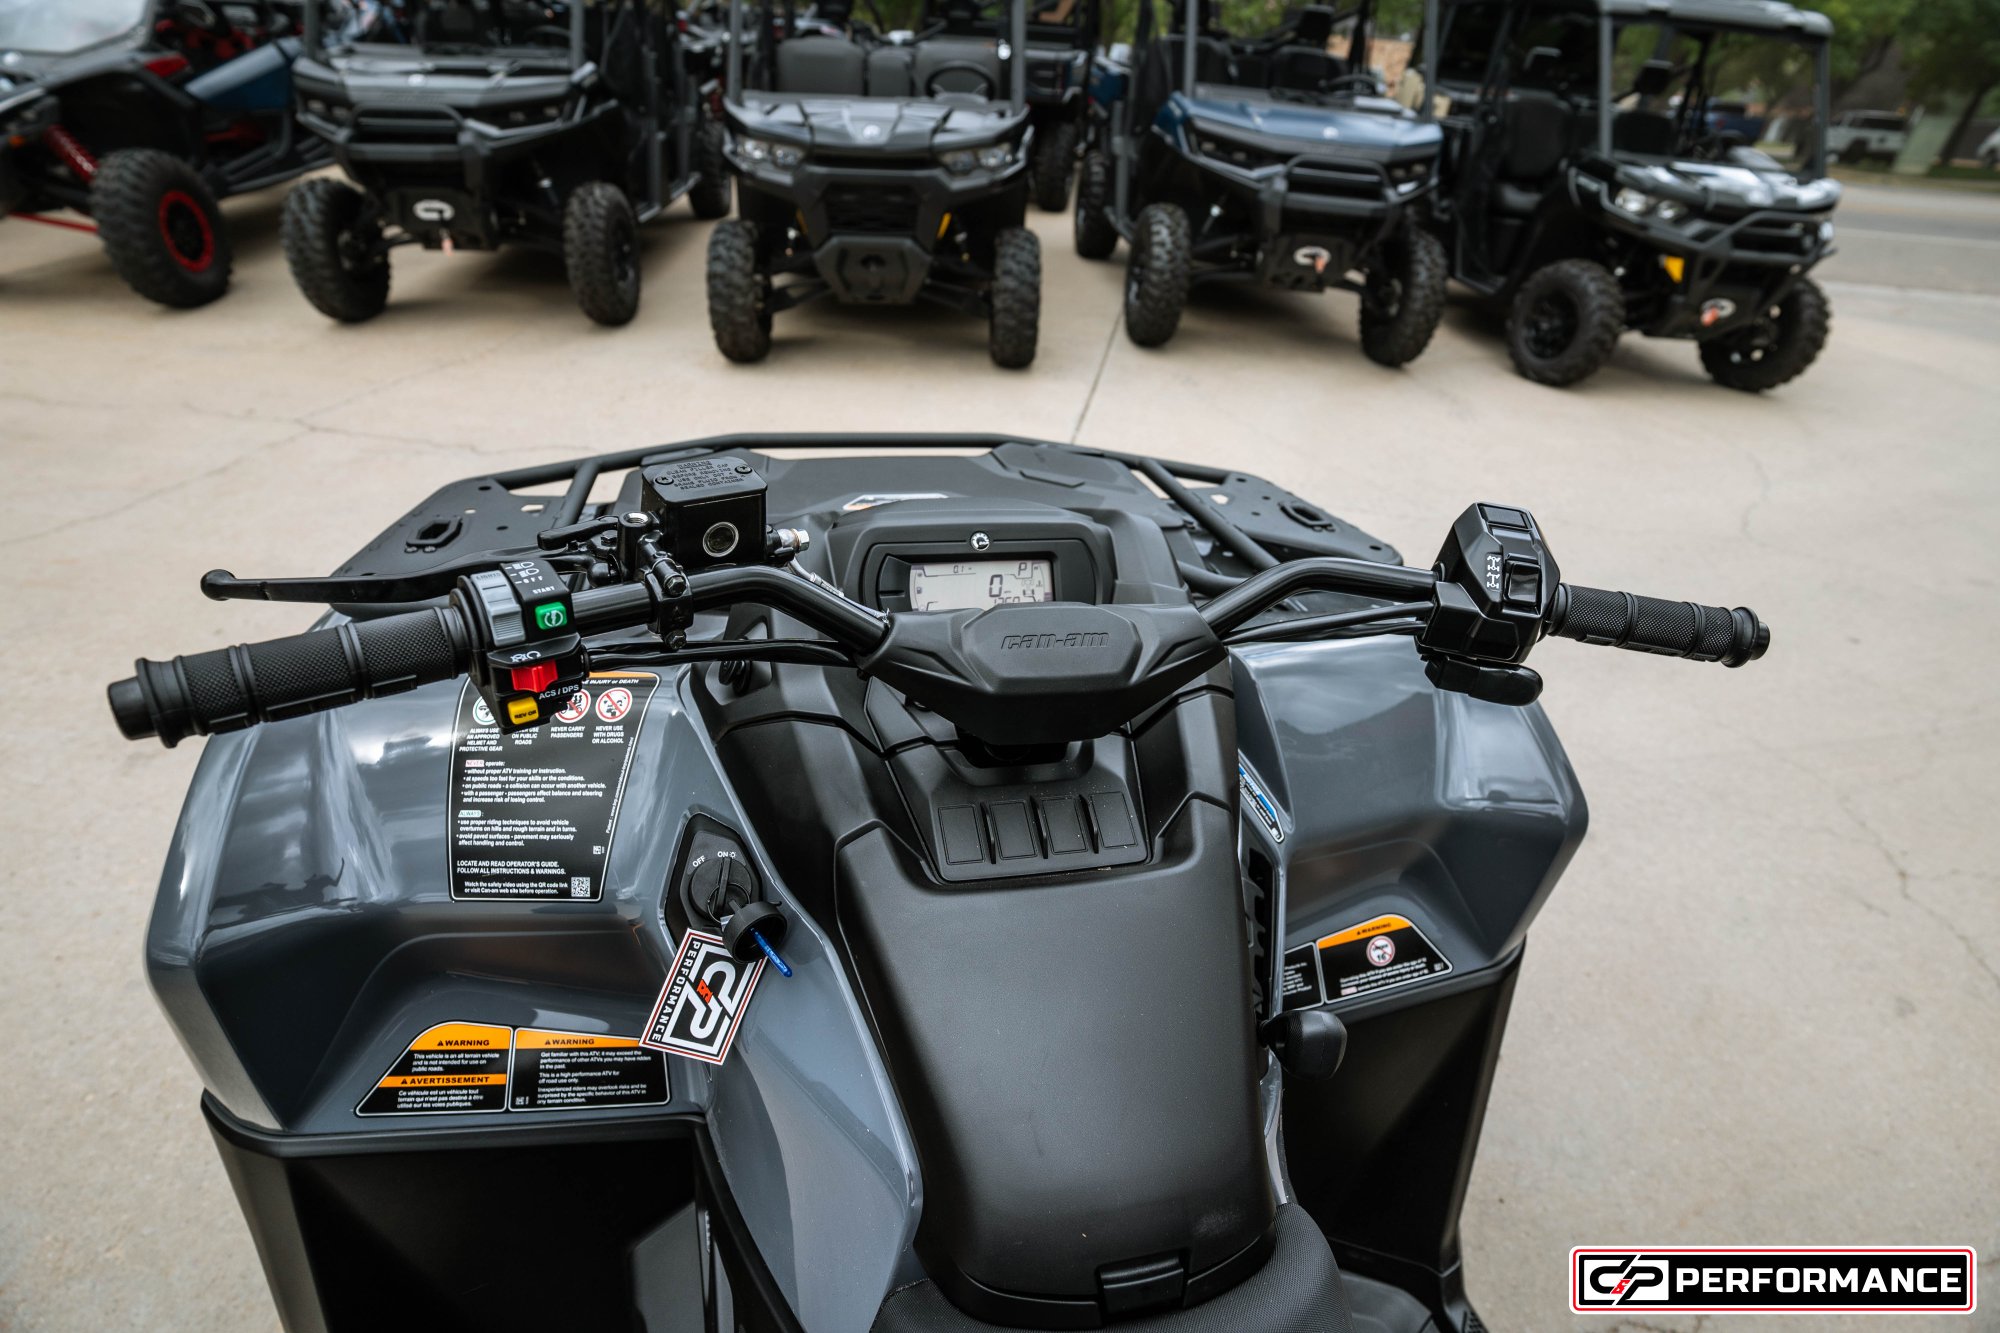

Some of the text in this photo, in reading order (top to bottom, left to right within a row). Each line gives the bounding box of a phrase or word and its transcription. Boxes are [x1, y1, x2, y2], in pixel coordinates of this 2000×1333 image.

[533, 586, 555, 594] START
[989, 574, 1003, 597] 0
[1002, 632, 1109, 650] can-am
[539, 691, 557, 700] ACS
[562, 684, 579, 693] DPS
[692, 855, 705, 868] OFF
[651, 940, 701, 1042] PERFORMANCE
[410, 1077, 490, 1085] AVERTISSEMENT
